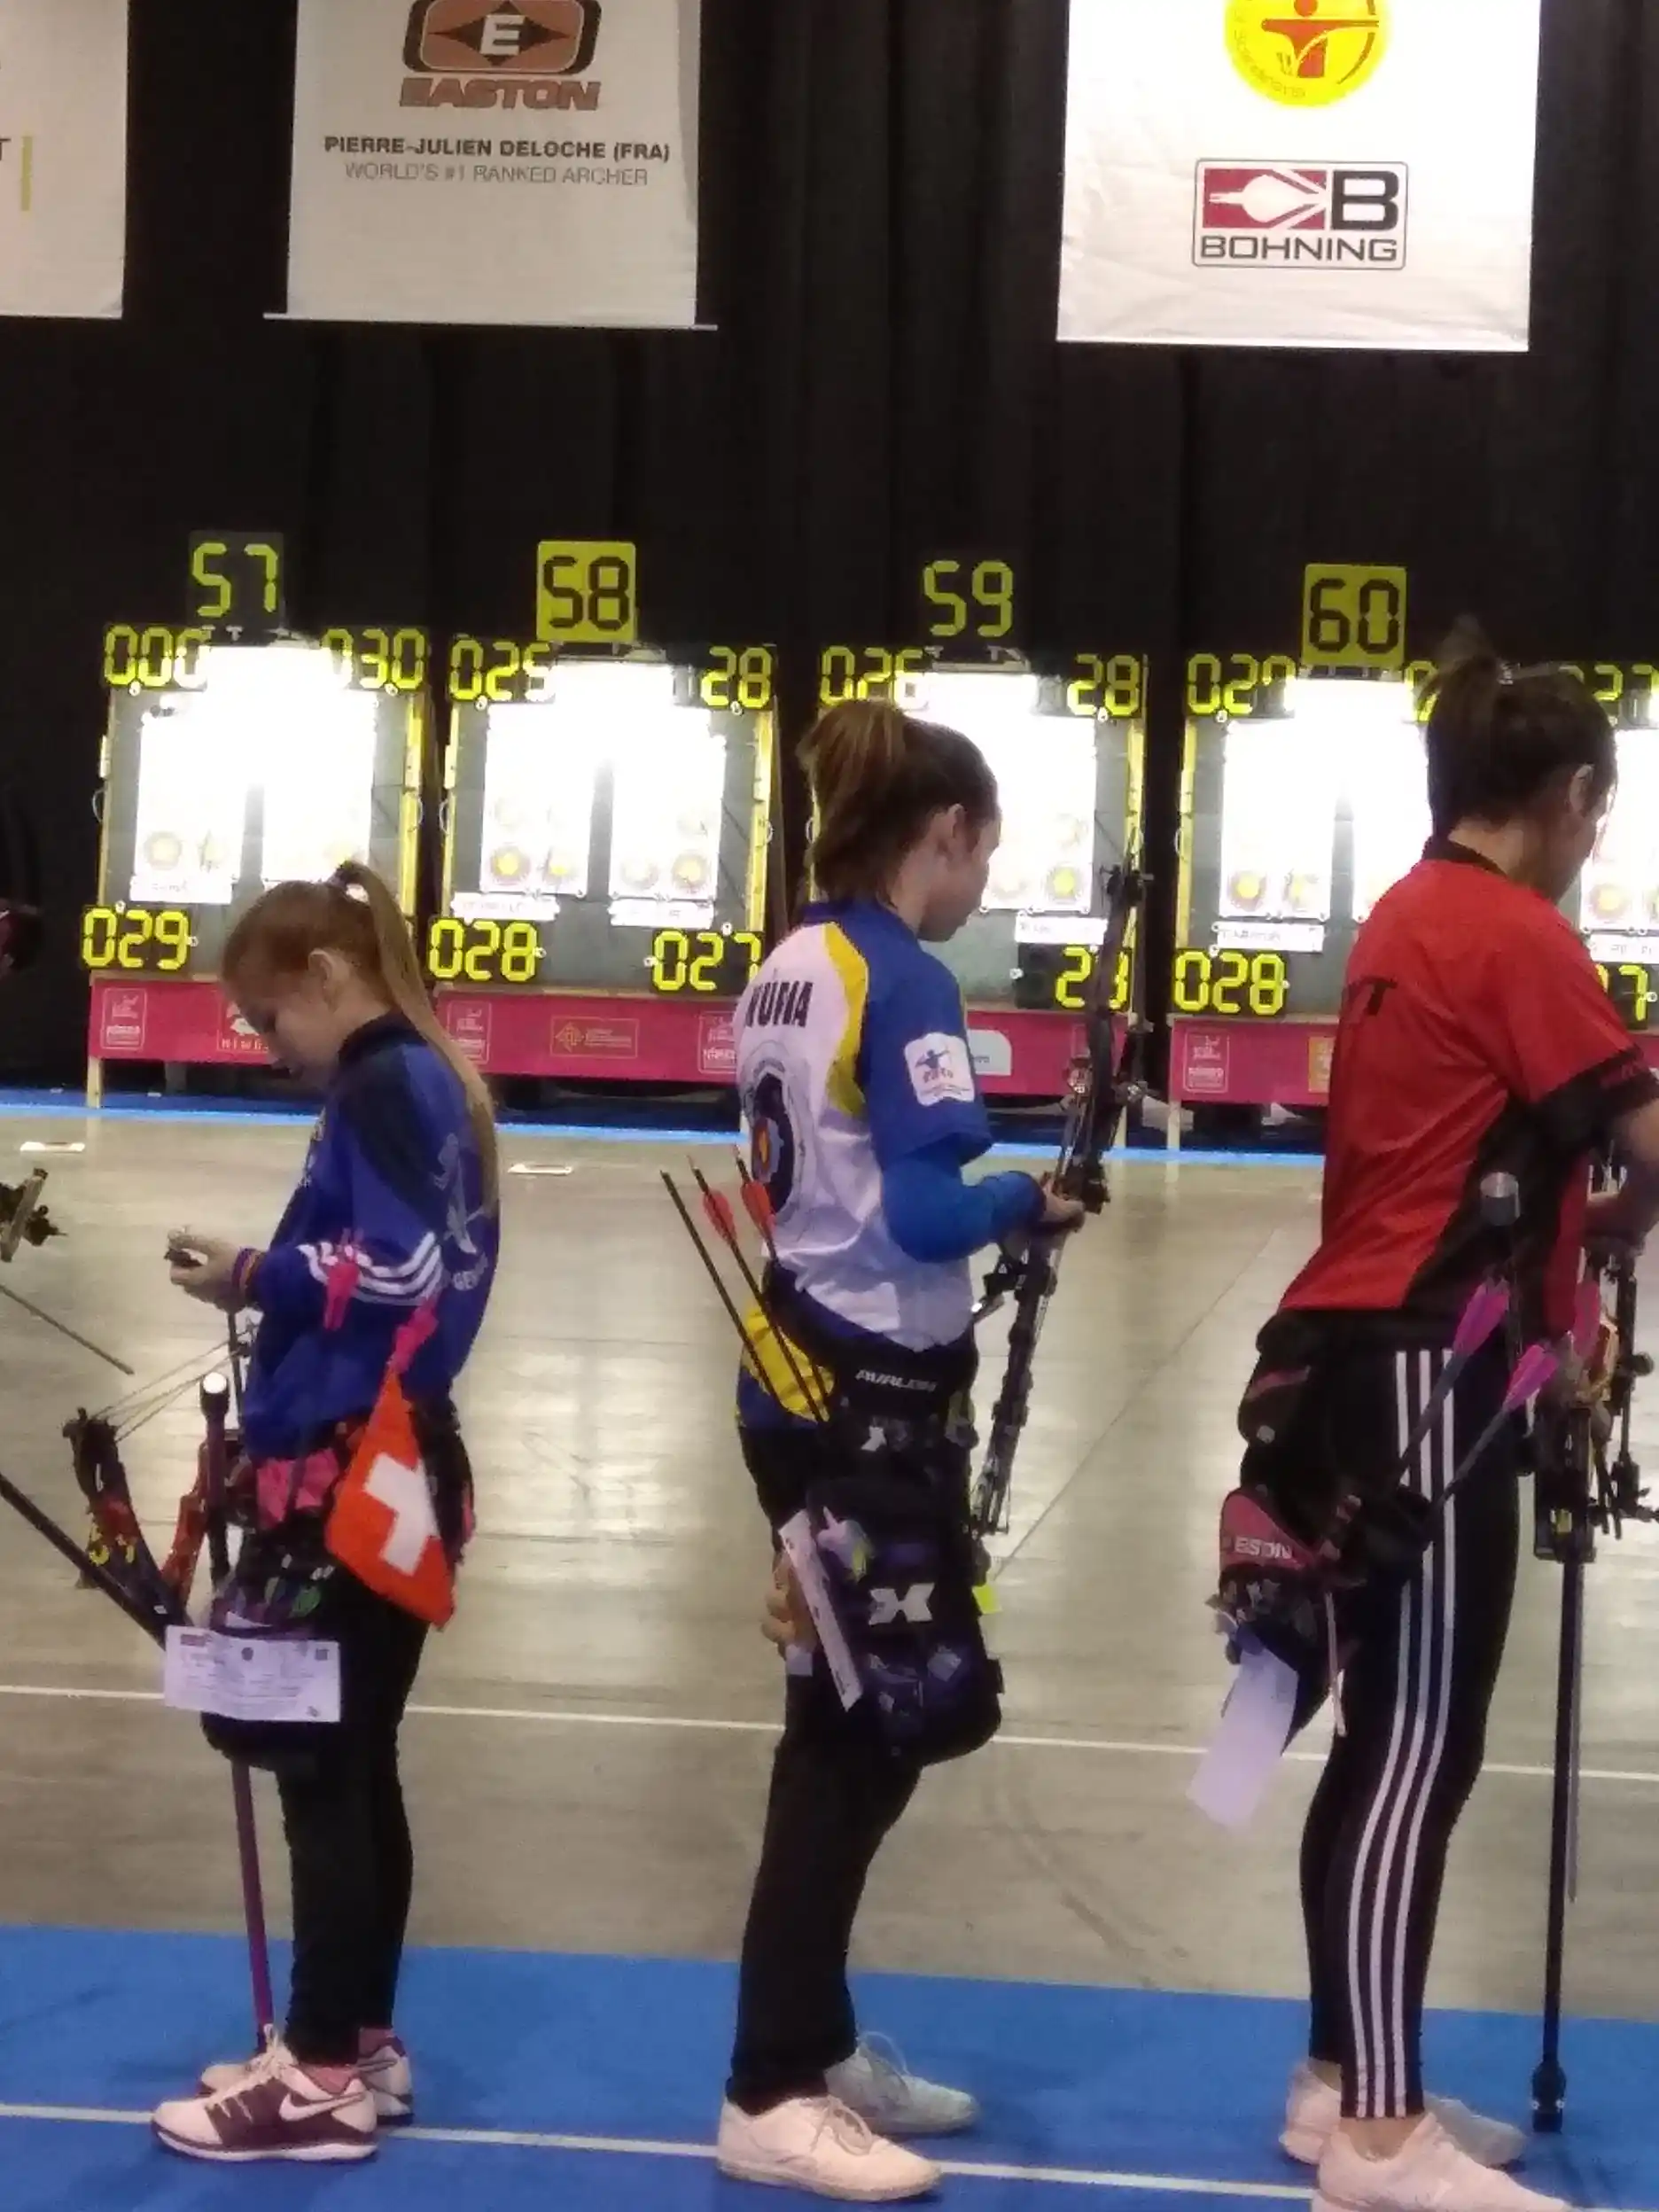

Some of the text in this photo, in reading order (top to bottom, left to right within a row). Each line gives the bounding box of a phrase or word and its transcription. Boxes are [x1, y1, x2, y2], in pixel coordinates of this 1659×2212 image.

[398, 77, 603, 111] EASTON
[323, 136, 671, 163] PIERRE-JULIEN DELOCHE (FRA)
[344, 161, 649, 186] WORLD'S #1 RANKED ARCHER
[1331, 169, 1399, 230] B
[1199, 236, 1398, 262] BOHNING
[191, 541, 279, 618] 57
[543, 555, 630, 631] 58
[923, 559, 1015, 638] 59
[1307, 578, 1401, 655] 60
[82, 907, 191, 970] 029
[428, 916, 539, 982] 028
[651, 929, 763, 993] 027
[1174, 951, 1285, 1016] 028
